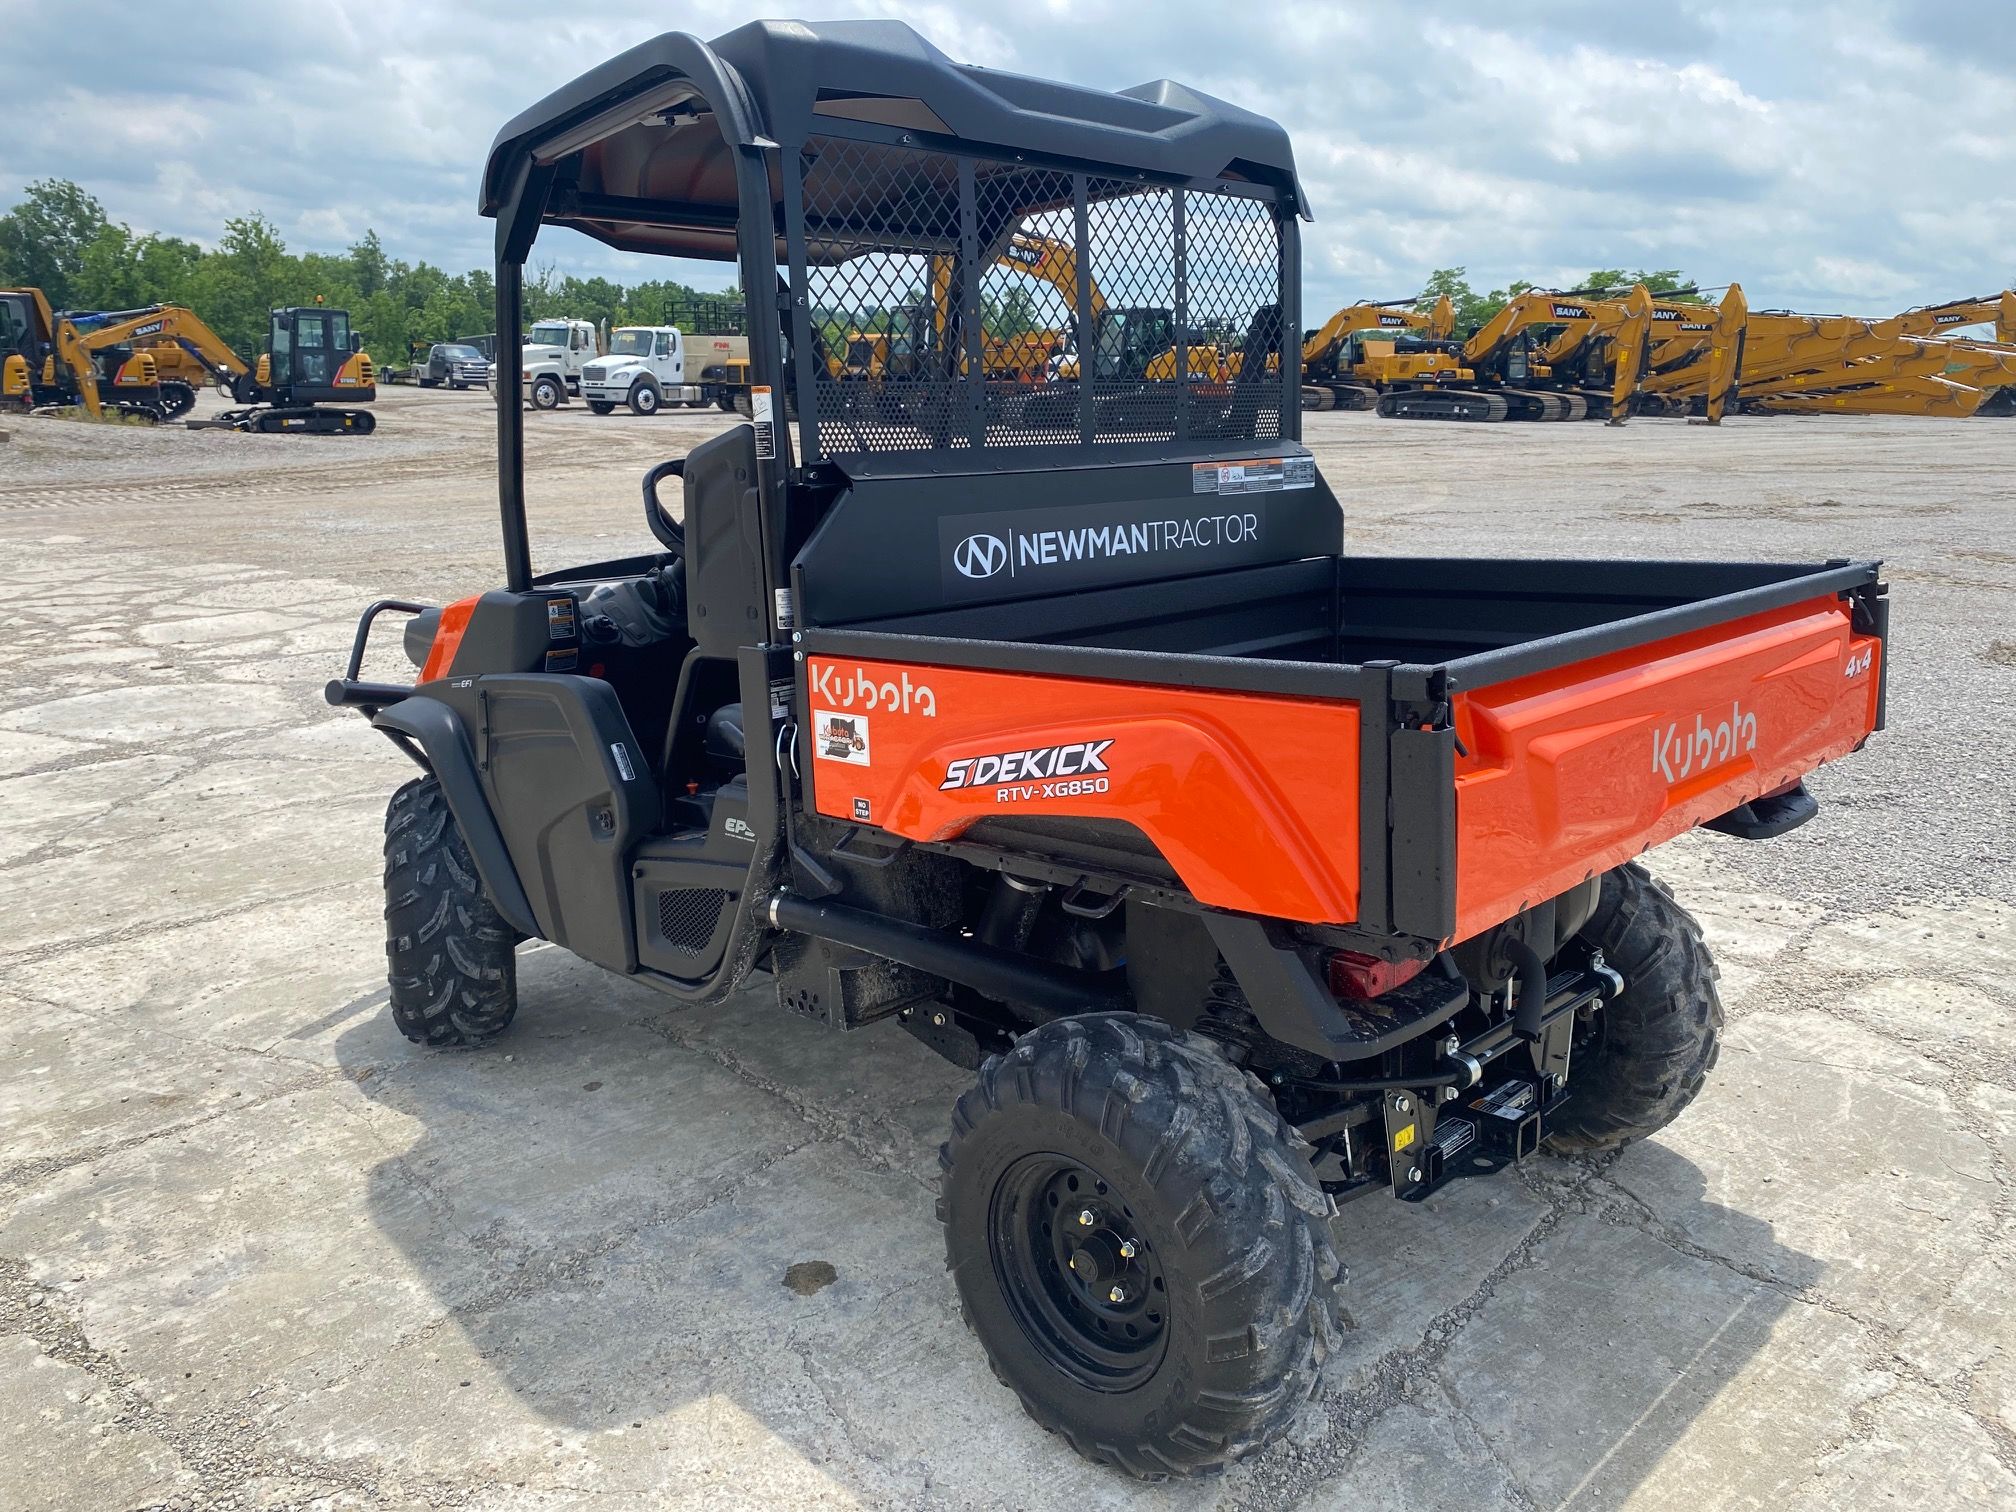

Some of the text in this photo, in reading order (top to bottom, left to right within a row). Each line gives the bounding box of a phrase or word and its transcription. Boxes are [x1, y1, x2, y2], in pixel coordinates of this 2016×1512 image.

[1555, 307, 1583, 317] SANY
[1937, 315, 1961, 323] SANY
[1381, 317, 1402, 325] SANY
[134, 321, 162, 336] SANY
[1844, 648, 1872, 678] 4x4
[812, 664, 936, 717] Kubota
[823, 723, 849, 737] Kubota
[1652, 701, 1757, 783] Kubota
[940, 741, 1114, 790] SIDEKICK
[997, 777, 1109, 802] RTV-XG850
[857, 801, 867, 809] NO
[855, 808, 870, 818] STEP
